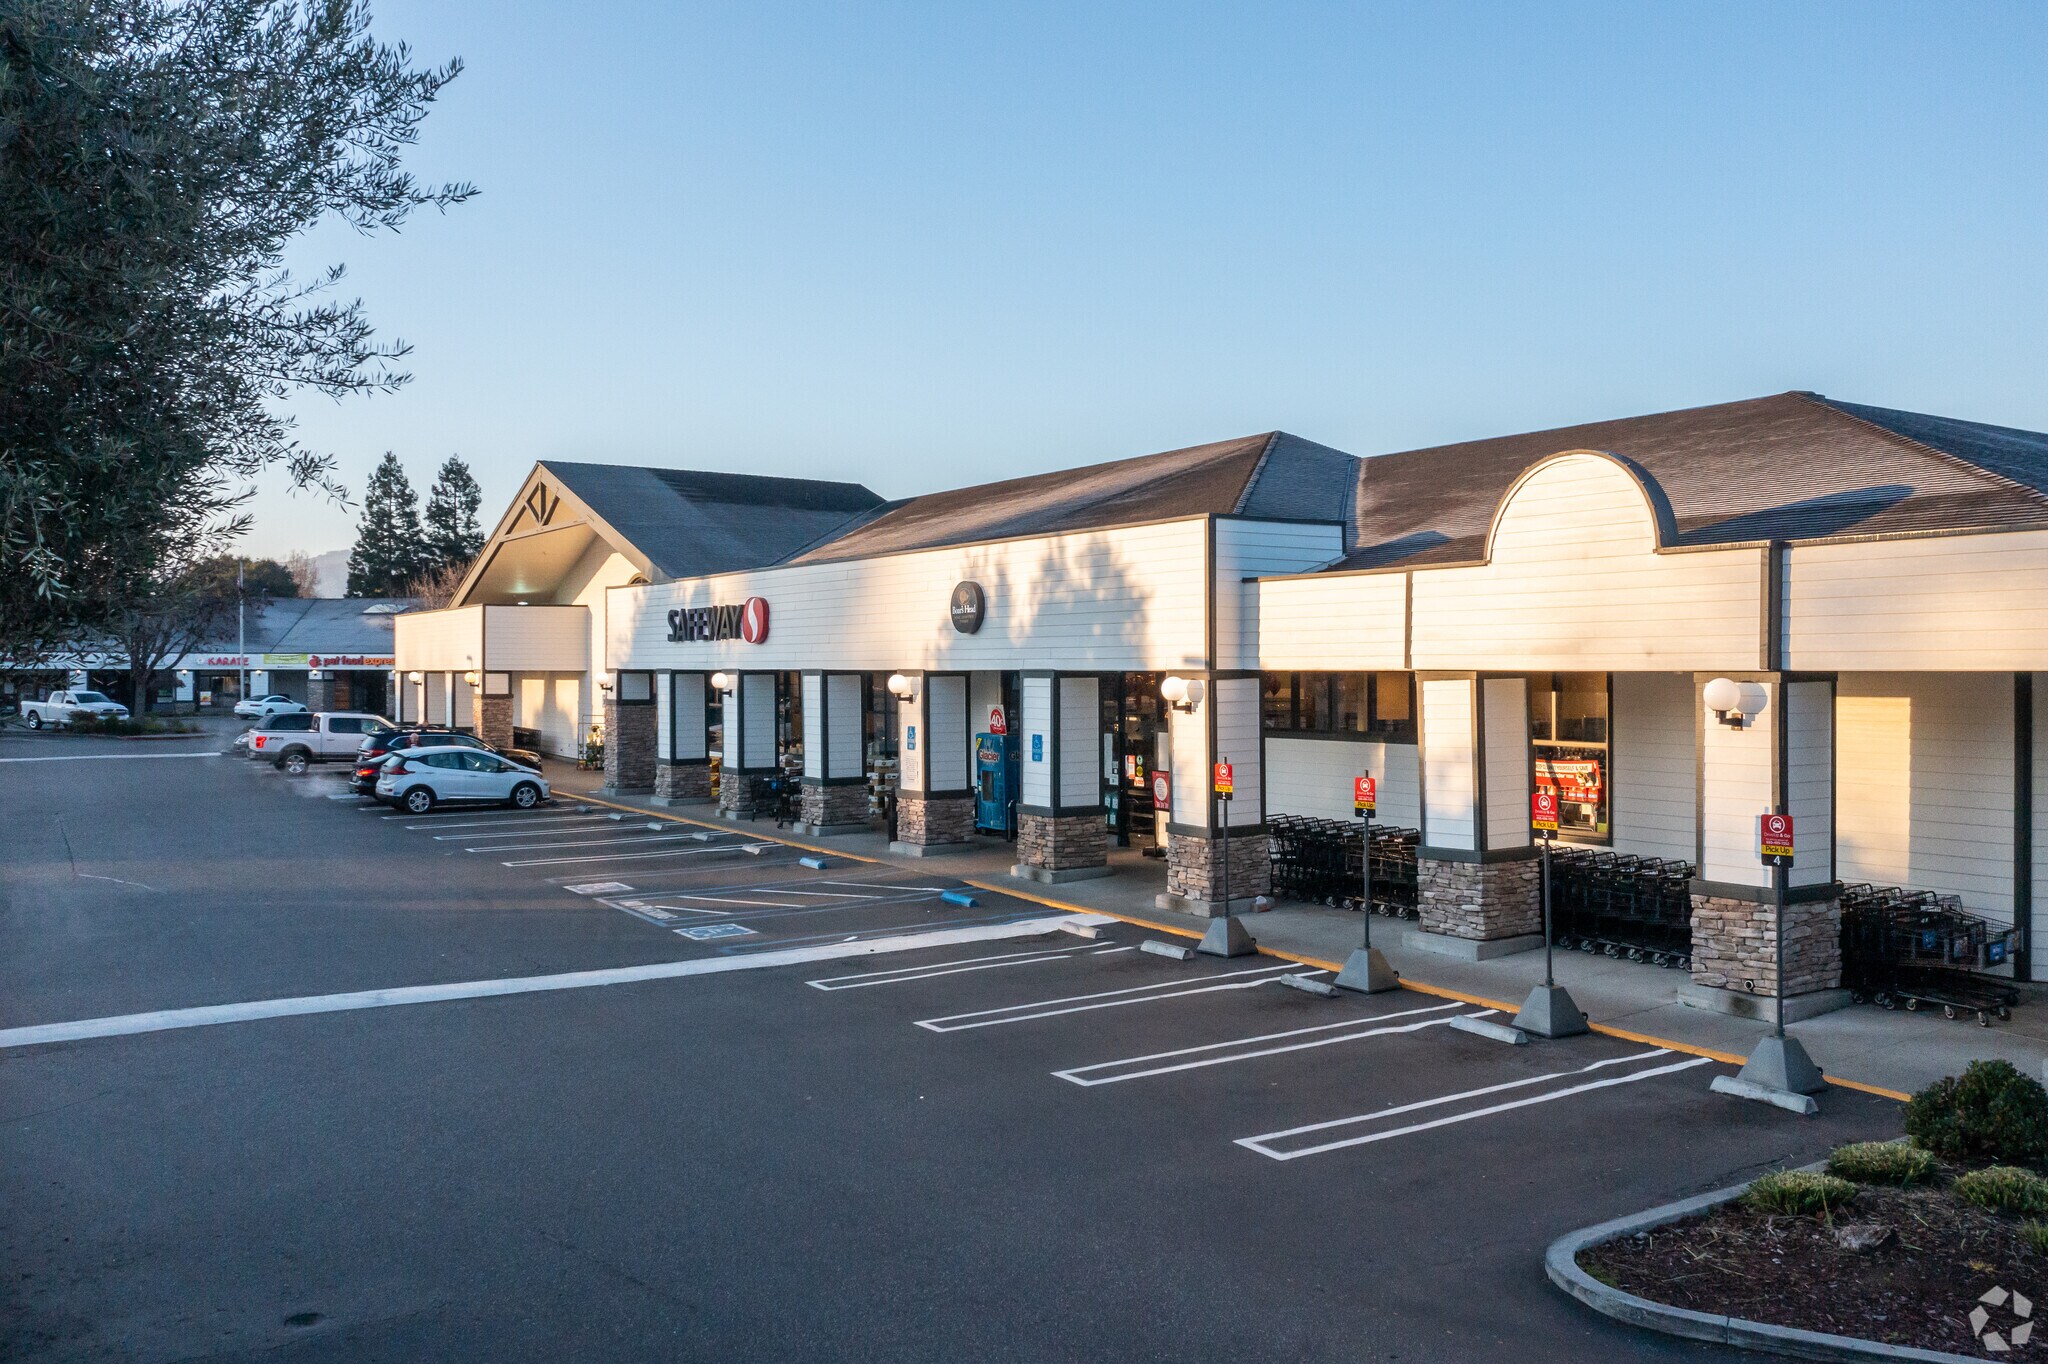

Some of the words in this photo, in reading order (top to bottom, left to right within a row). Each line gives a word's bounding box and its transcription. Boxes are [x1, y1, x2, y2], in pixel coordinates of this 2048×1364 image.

[667, 604, 746, 642] SAFEWAY
[1362, 808, 1368, 817] 2
[1542, 830, 1548, 839] 3
[1780, 847, 1789, 855] Up
[1773, 855, 1781, 865] 4
